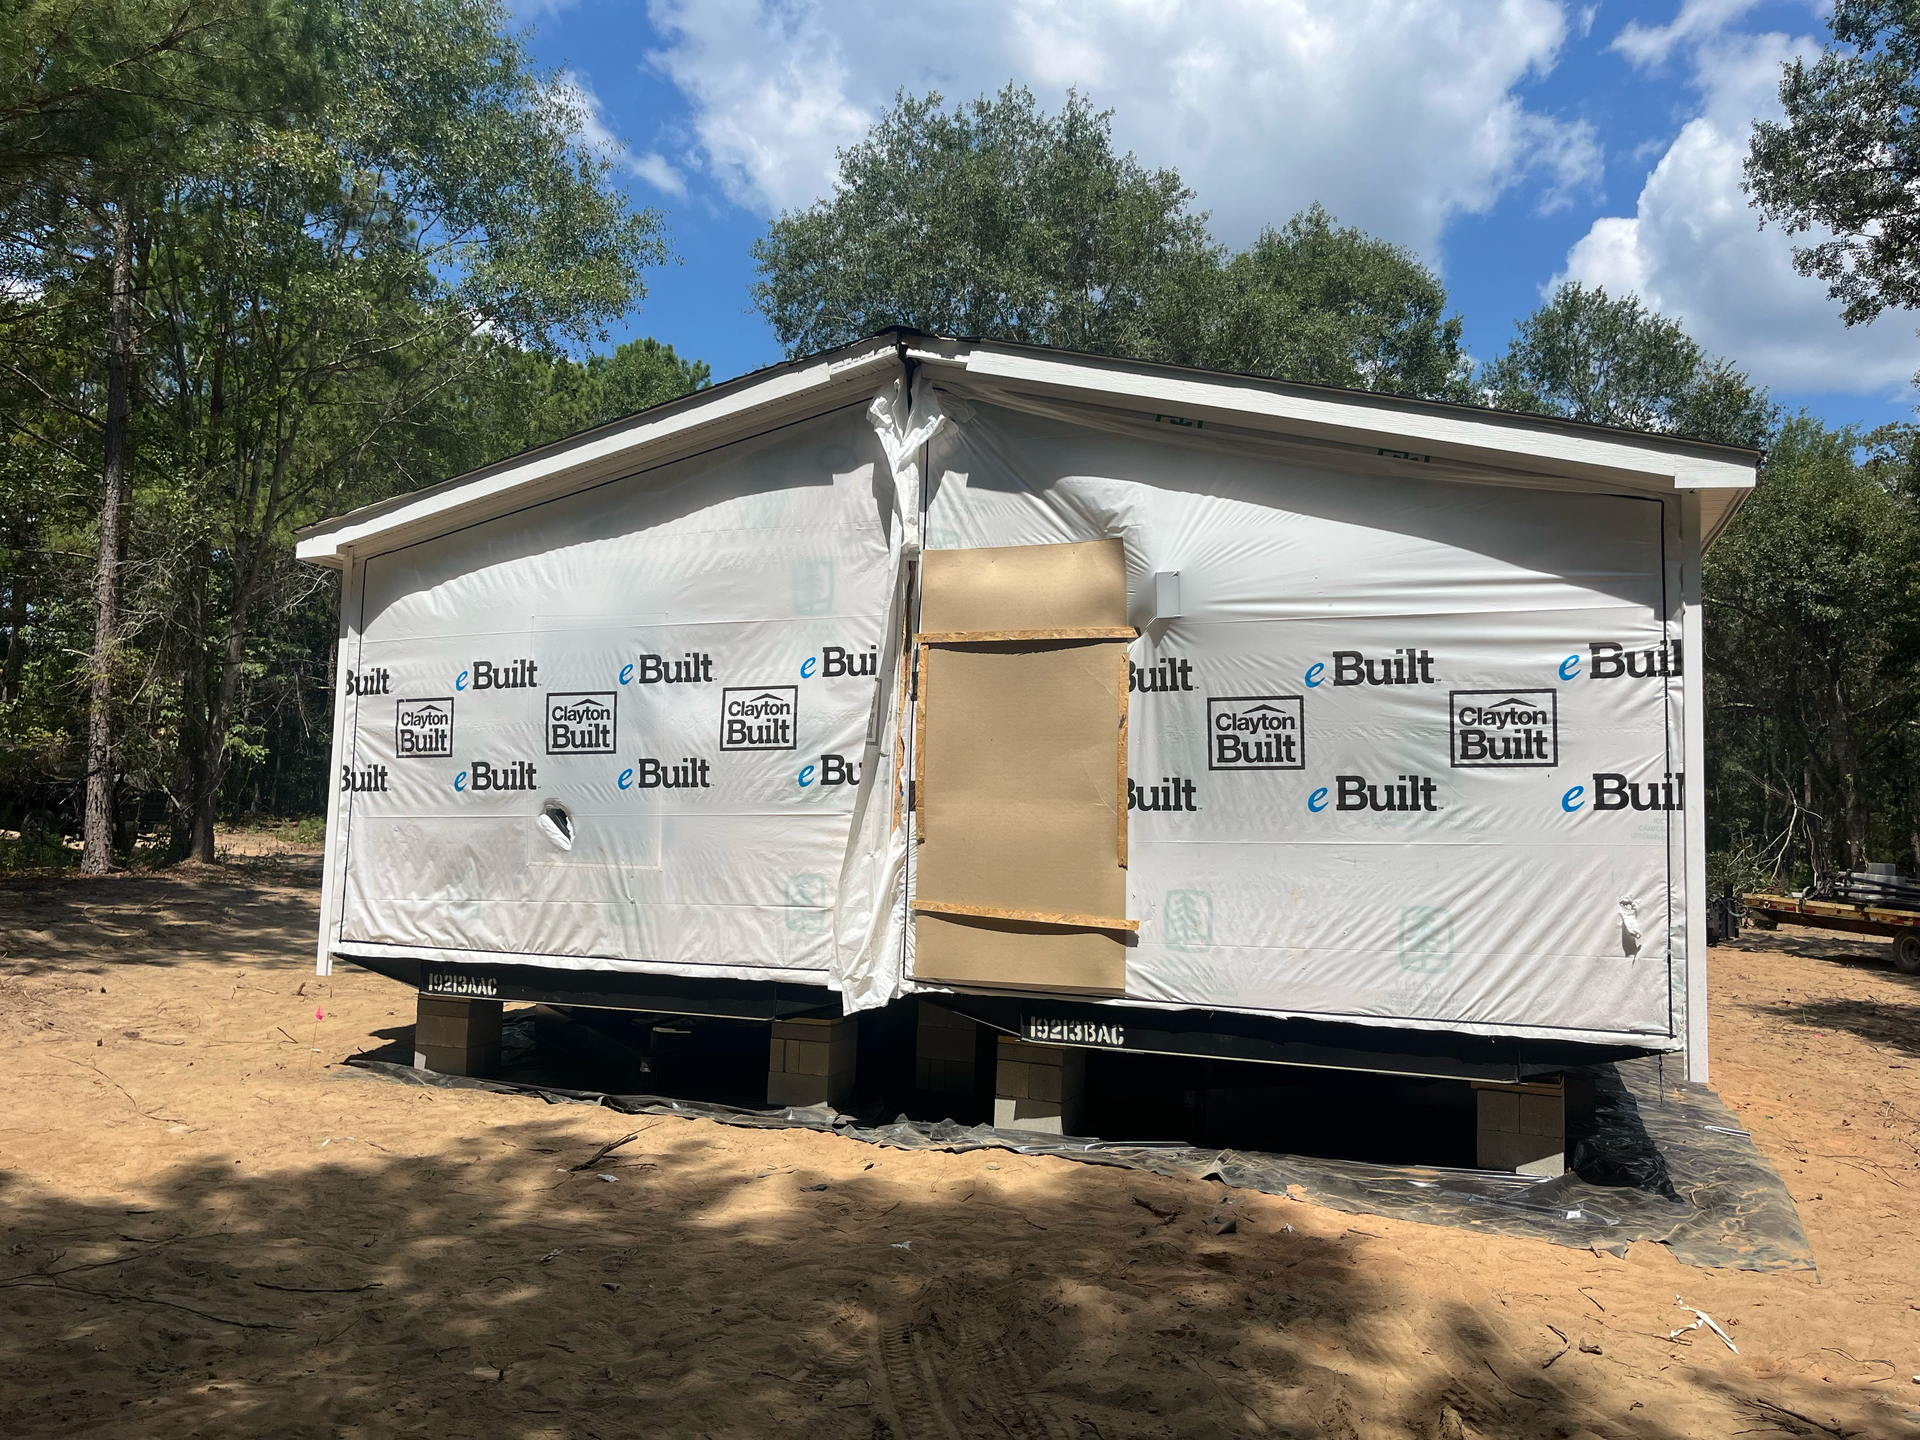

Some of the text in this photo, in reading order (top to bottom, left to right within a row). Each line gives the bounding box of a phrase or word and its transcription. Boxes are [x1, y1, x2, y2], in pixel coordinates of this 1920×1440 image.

[401, 711, 449, 729] Clayton
[551, 705, 611, 724] Clayton
[728, 700, 791, 720] Clayton
[1458, 706, 1548, 730] Clayton
[726, 718, 790, 745] Built
[1215, 712, 1296, 734] Clayton
[400, 728, 448, 752] Built
[551, 724, 611, 749] Built
[1216, 733, 1297, 764] Built
[1459, 728, 1548, 760] Built
[428, 972, 498, 996] 19213AAC
[1030, 1016, 1124, 1045] 19213BAC
